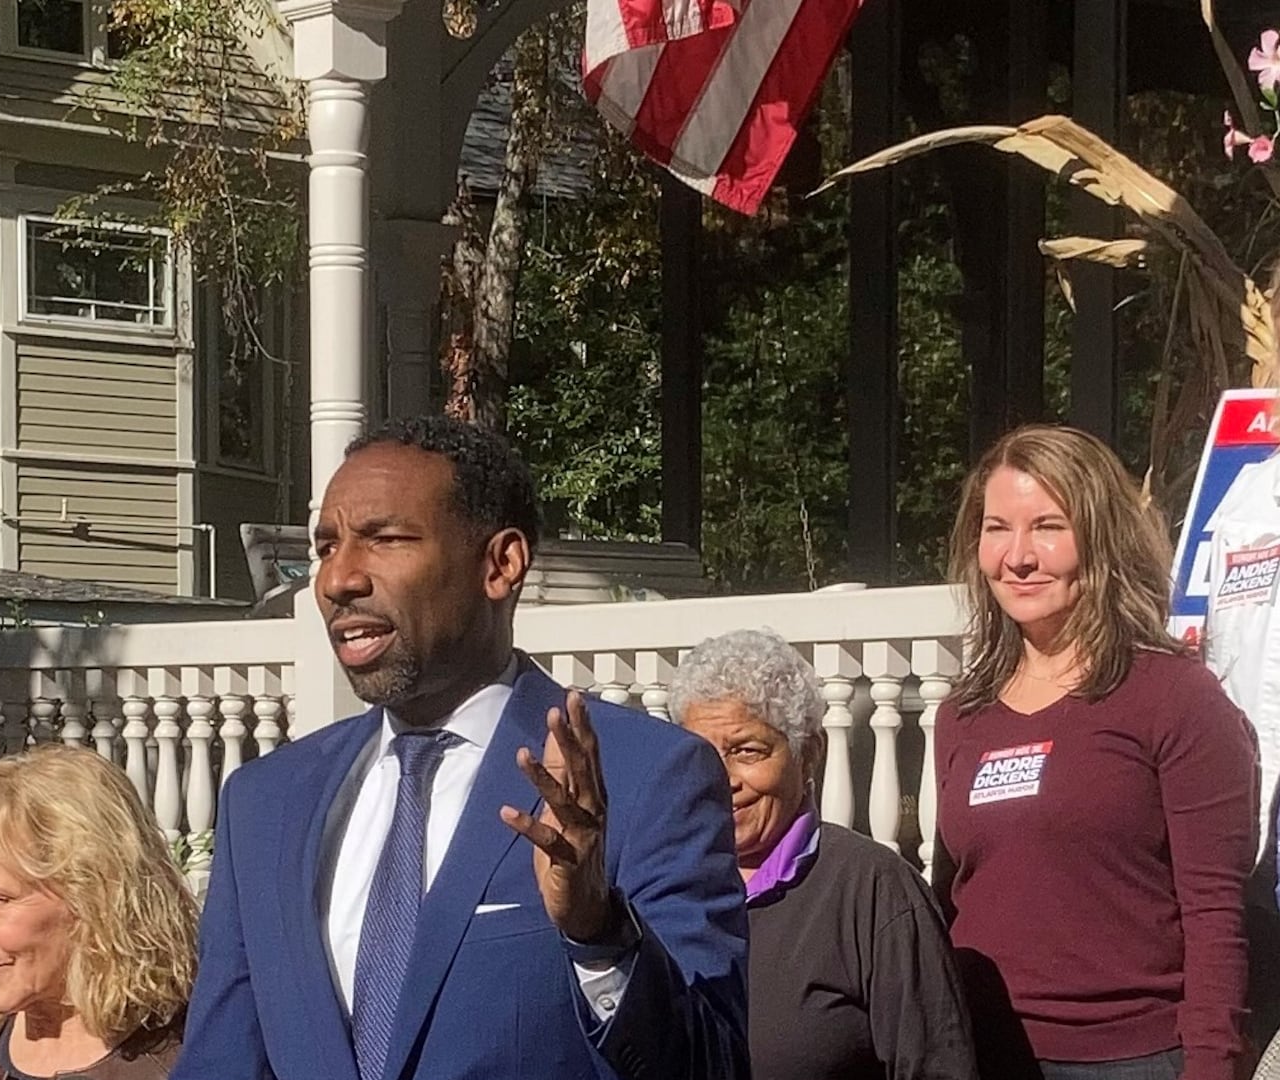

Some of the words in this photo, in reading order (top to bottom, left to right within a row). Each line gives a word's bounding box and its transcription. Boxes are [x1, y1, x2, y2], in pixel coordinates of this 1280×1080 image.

[1226, 557, 1280, 582] ANDRE
[1222, 574, 1273, 592] DICKENS
[977, 754, 1046, 777] ANDRE
[973, 769, 1040, 789] DICKENS
